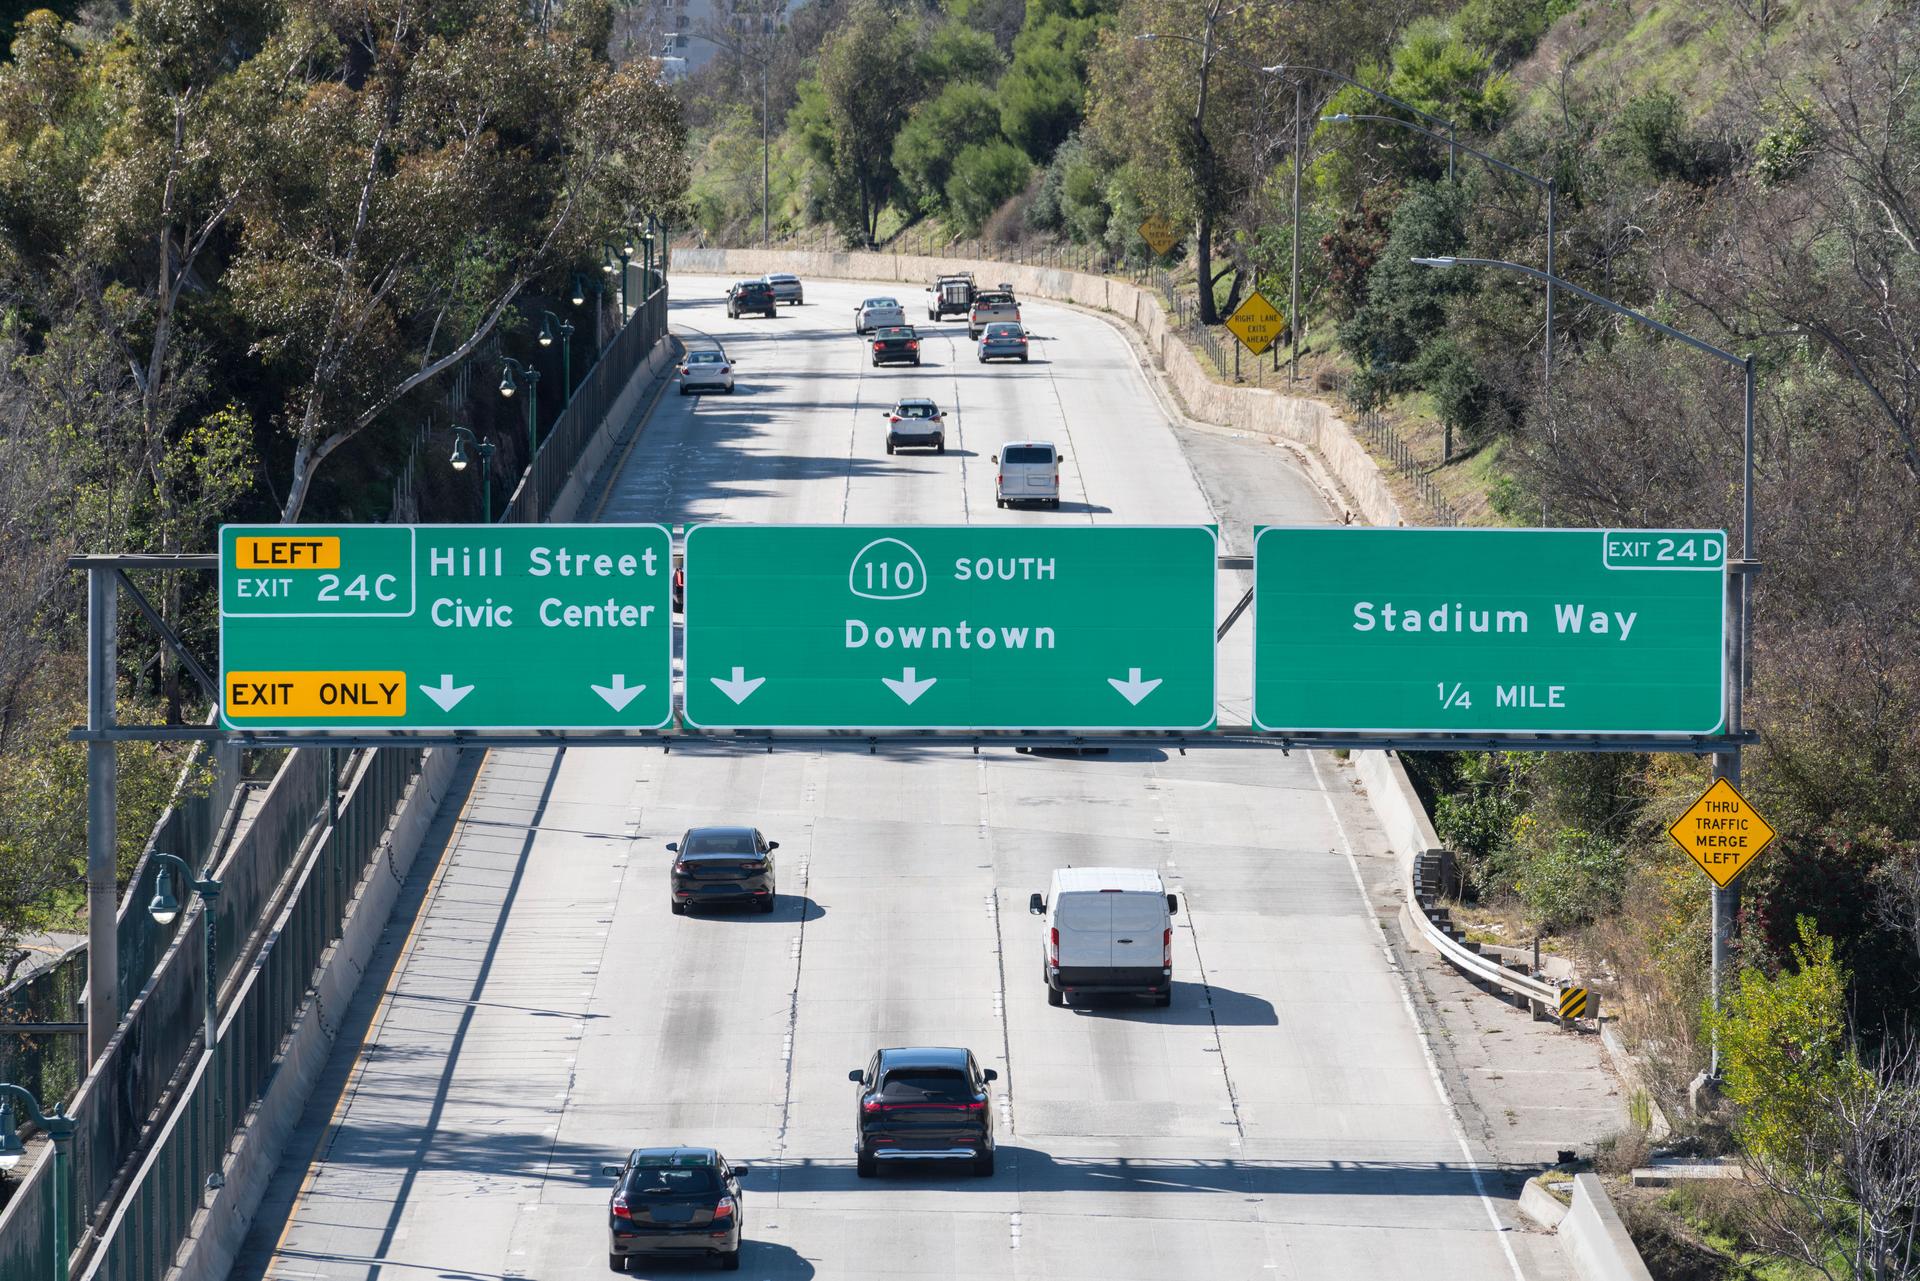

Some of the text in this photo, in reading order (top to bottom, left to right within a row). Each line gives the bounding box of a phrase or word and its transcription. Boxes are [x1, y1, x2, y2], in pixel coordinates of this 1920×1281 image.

[1248, 325, 1266, 333] EXITS
[253, 543, 323, 564] LEFT
[1608, 542, 1651, 557] EXIT
[430, 547, 657, 577] Hill Street
[865, 557, 1055, 590] 110 SOUTH
[237, 574, 397, 602] EXIT 24C
[431, 598, 655, 628] Civic Center
[1353, 602, 1638, 641] Stadium Way
[845, 619, 1055, 649] Downtown
[232, 683, 400, 706] EXIT ONLY
[1496, 685, 1566, 708] MILE
[1705, 801, 1739, 813] THRU
[1696, 818, 1748, 830] TRAFFIC
[1697, 836, 1748, 847] MERGE
[1704, 853, 1740, 864] LEFT
